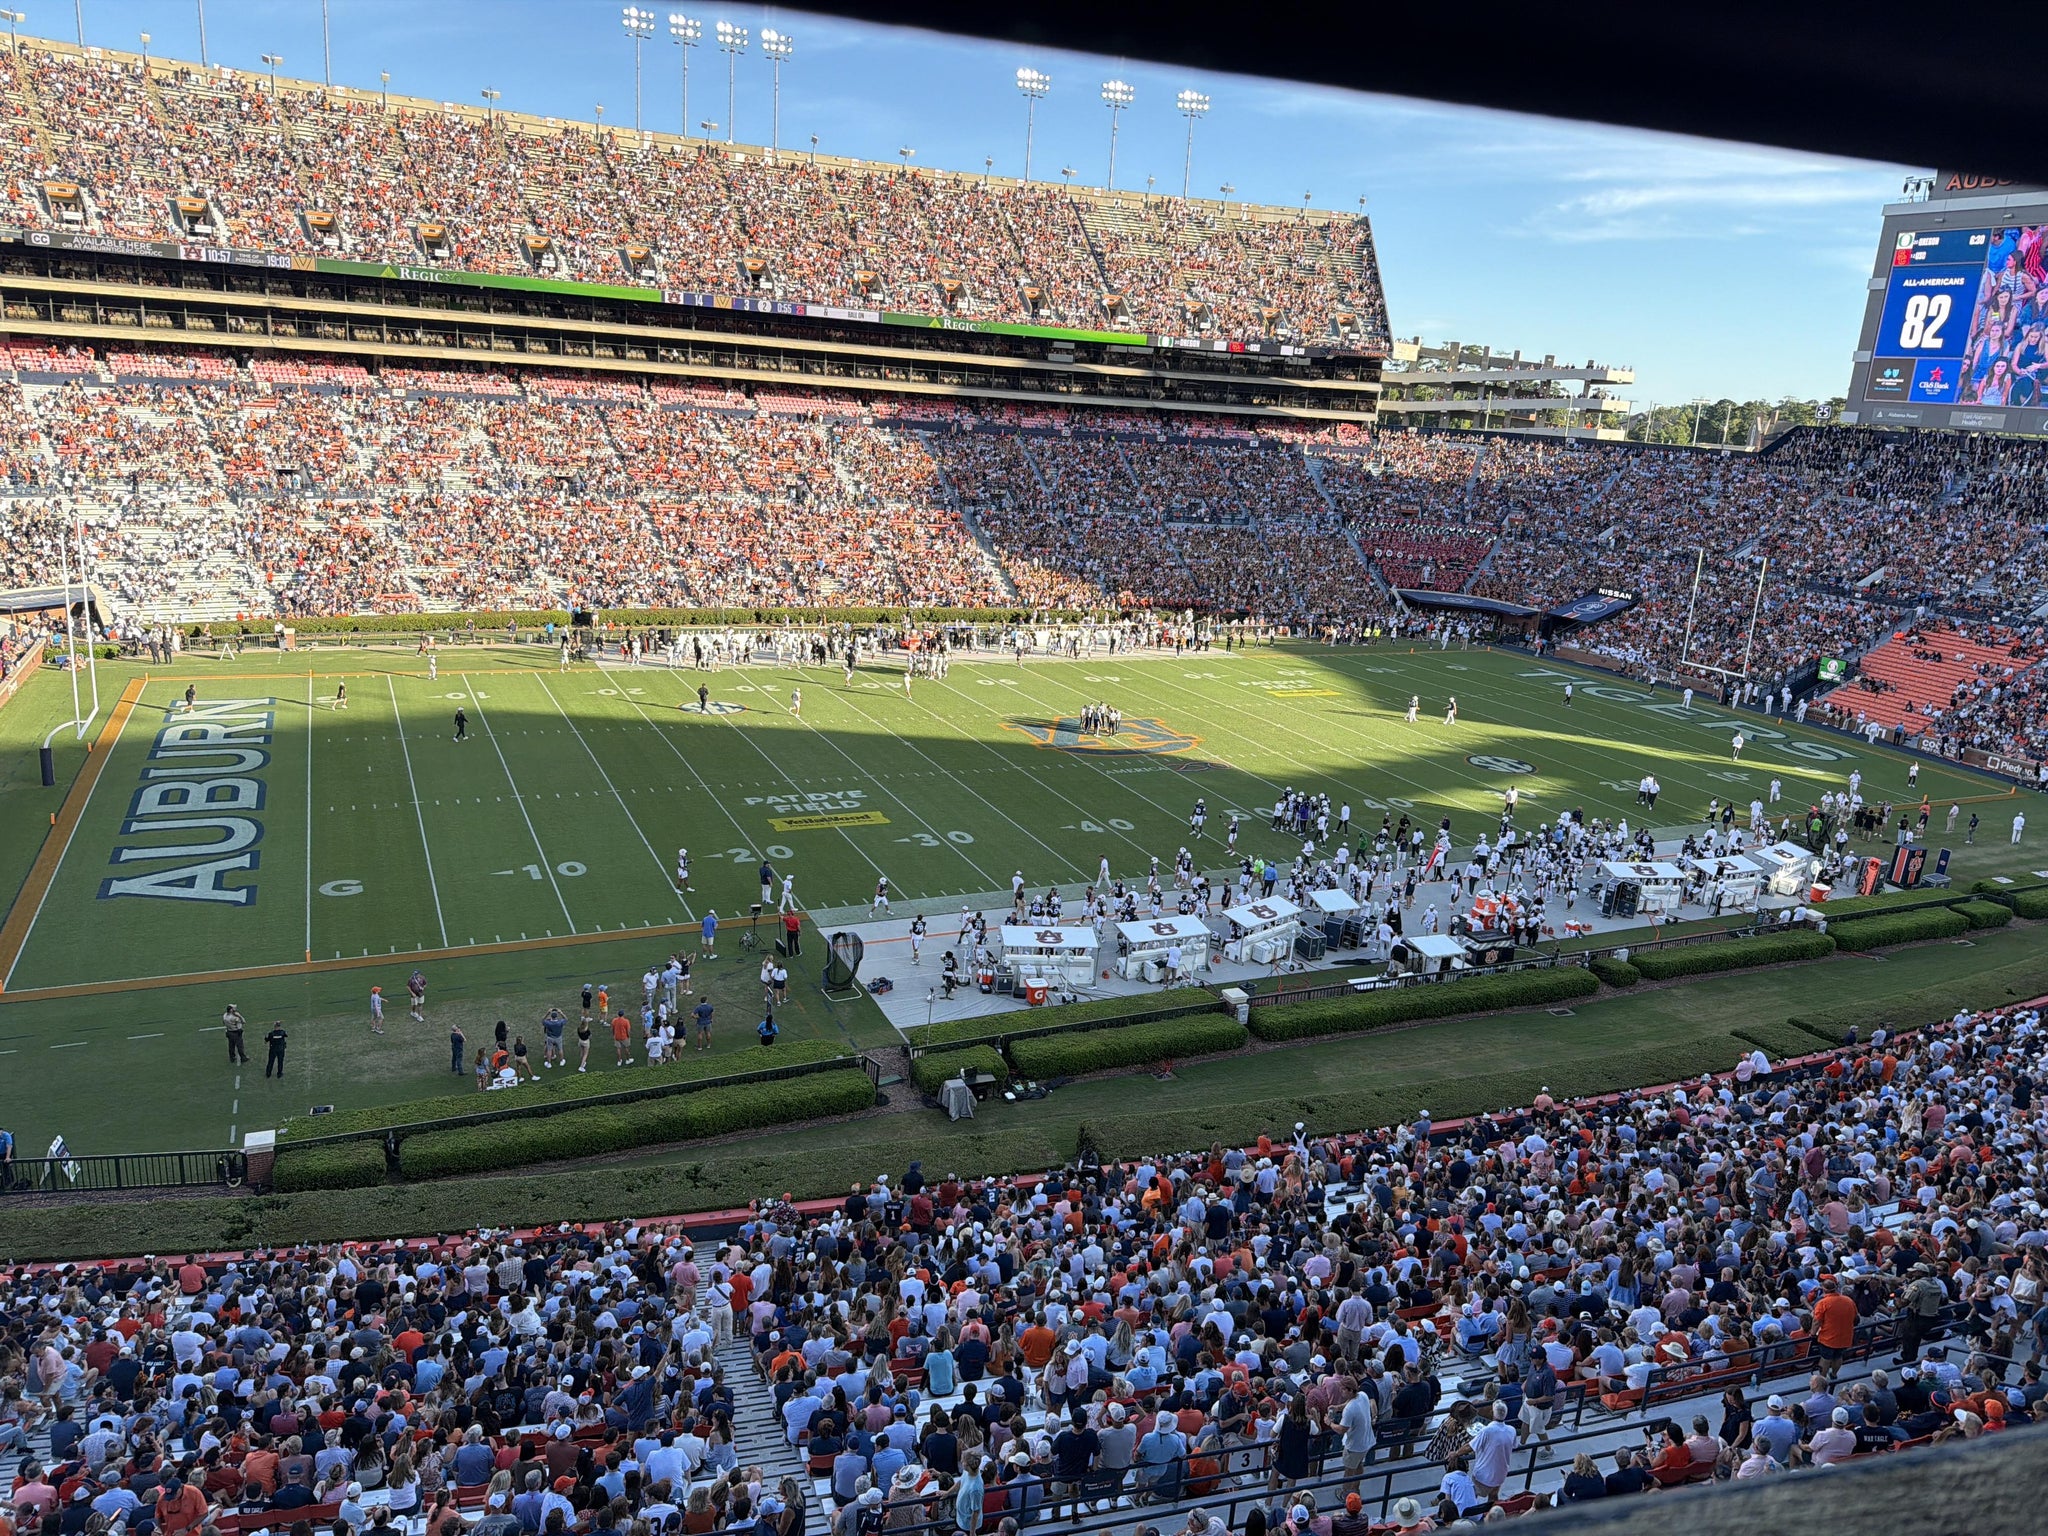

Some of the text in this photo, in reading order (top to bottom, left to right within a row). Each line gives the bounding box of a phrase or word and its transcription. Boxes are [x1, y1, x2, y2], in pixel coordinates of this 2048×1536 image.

[33, 234, 48, 244] CC
[73, 236, 152, 251] AVAILABLE HERE
[207, 249, 231, 263] 10:57
[266, 255, 291, 268] 19:03
[1902, 278, 1965, 287] ALL-AMERICANS
[694, 295, 703, 306] 14
[744, 300, 750, 311] 3
[777, 303, 792, 314] 0:55
[1899, 294, 1952, 349] 82
[1598, 588, 1632, 600] NISSAN
[1518, 667, 1858, 761] TIGERS
[1106, 766, 1168, 775] AMERICA
[97, 697, 275, 905] AUBURN
[744, 790, 868, 805] PAT DYE
[1362, 797, 1415, 811] 40
[774, 800, 861, 813] FIELD
[1222, 807, 1276, 822] 50
[1080, 818, 1135, 833] 40
[911, 831, 975, 847] 30
[726, 845, 794, 864] 20
[521, 861, 587, 880] 10
[318, 879, 364, 897] G
[1033, 990, 1044, 1000] G
[988, 1192, 995, 1203] 2
[1241, 1453, 1250, 1467] 3
